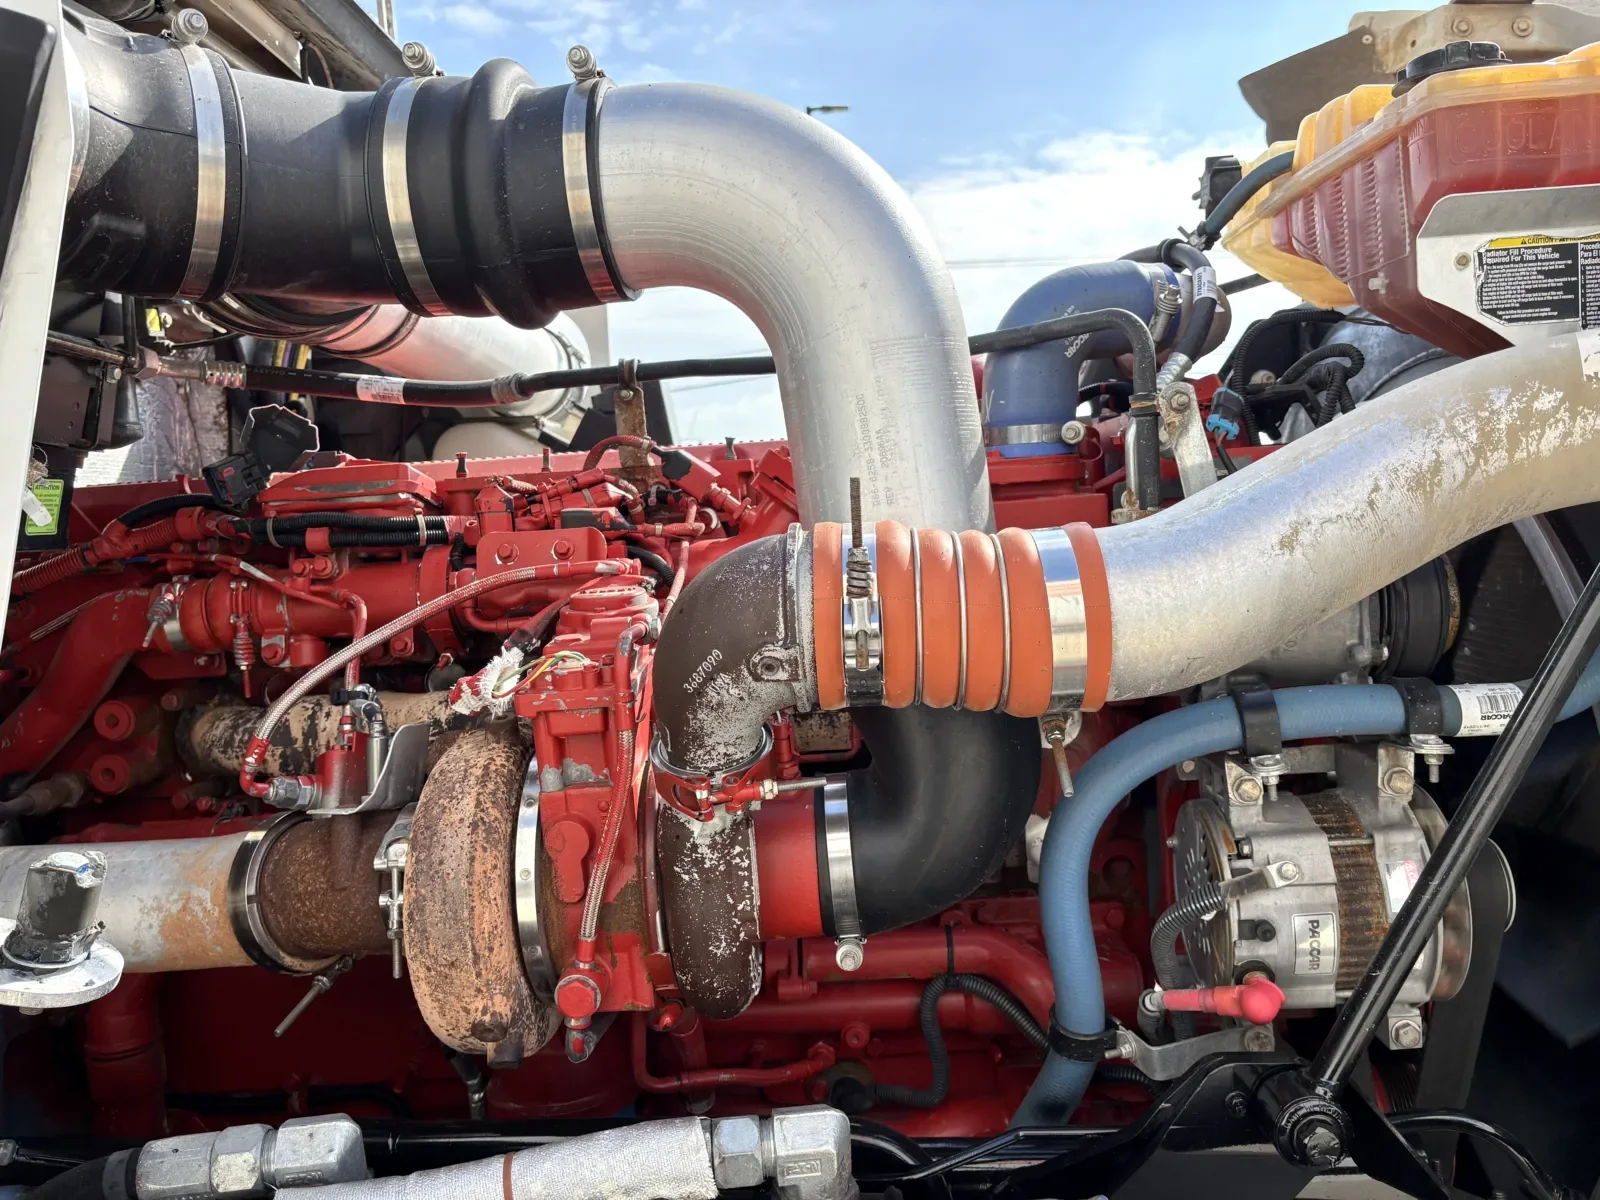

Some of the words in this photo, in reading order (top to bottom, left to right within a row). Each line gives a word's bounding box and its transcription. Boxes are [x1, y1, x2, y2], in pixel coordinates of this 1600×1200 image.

[1509, 247, 1520, 257] Fill
[1520, 246, 1552, 255] Procedure
[1511, 254, 1522, 263] For
[1523, 253, 1537, 261] This
[1537, 251, 1560, 260] Vehicle
[1063, 332, 1093, 358] ACCAR
[683, 649, 723, 693] 3687090
[1308, 919, 1321, 971] PACCAR
